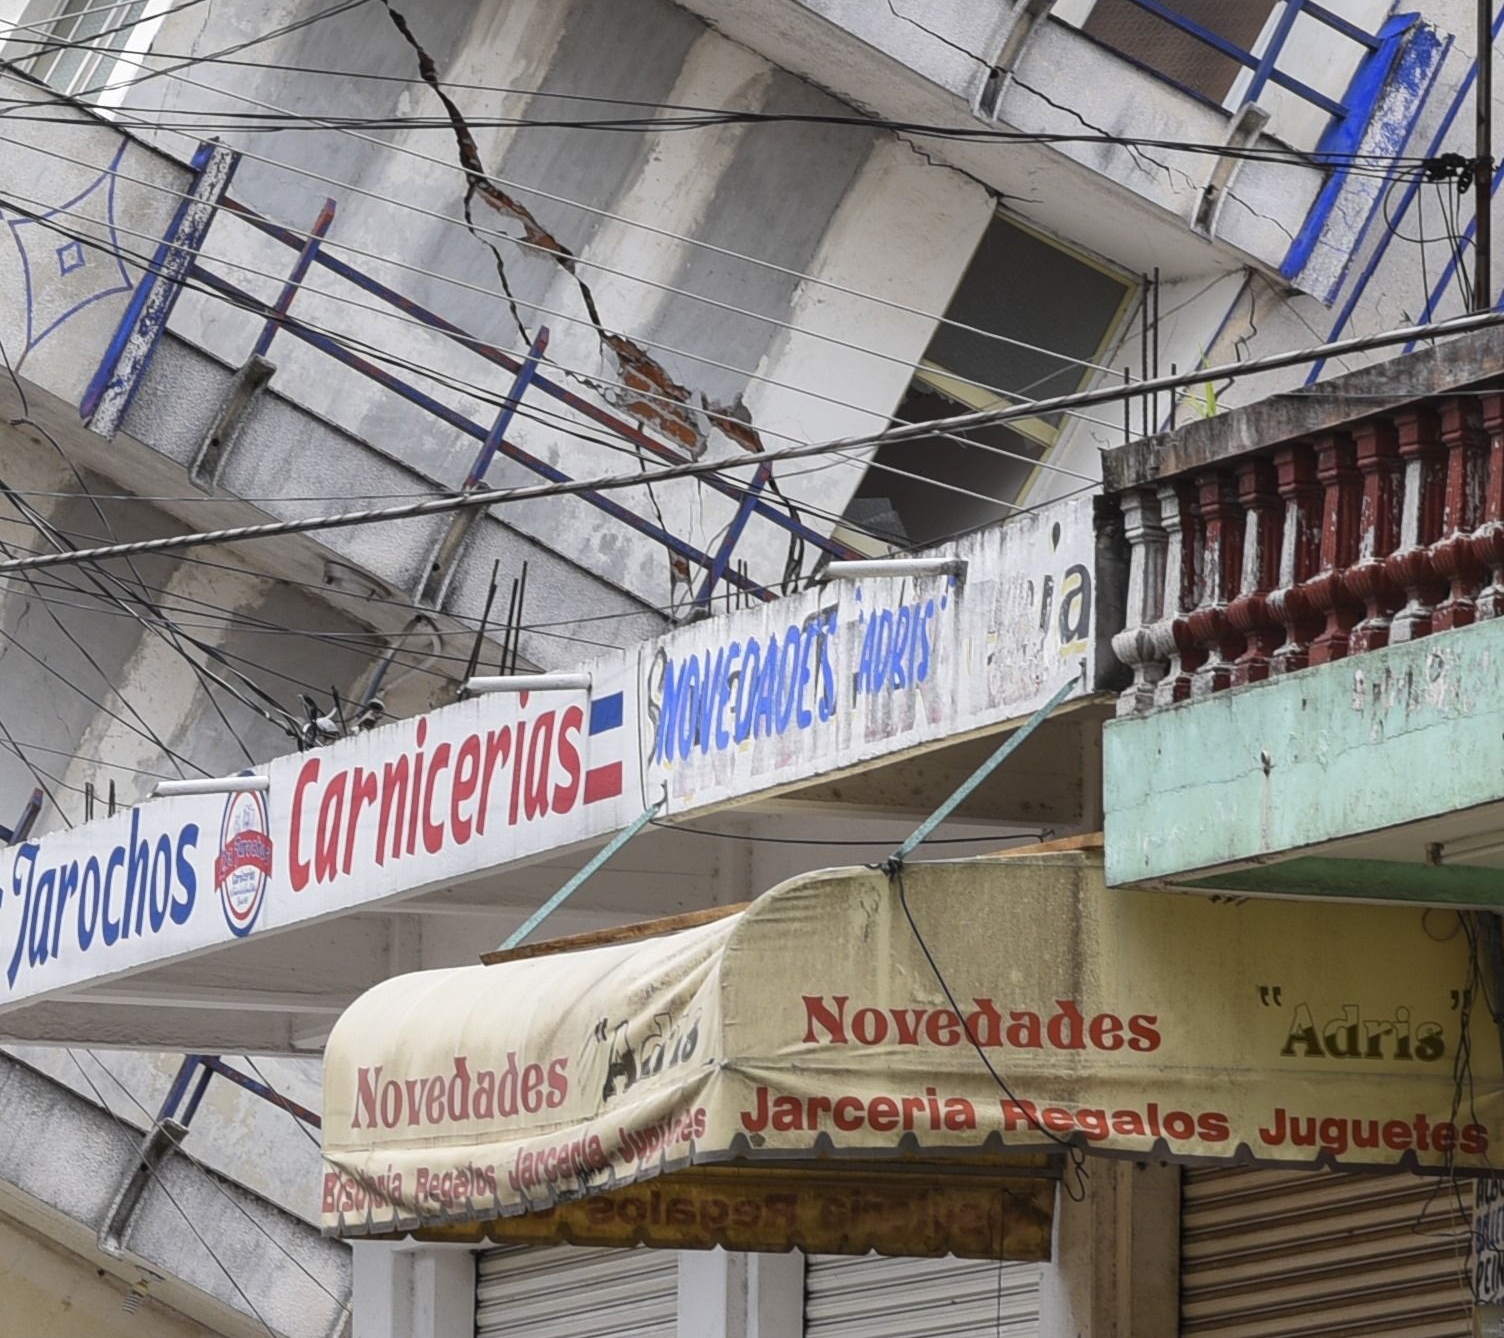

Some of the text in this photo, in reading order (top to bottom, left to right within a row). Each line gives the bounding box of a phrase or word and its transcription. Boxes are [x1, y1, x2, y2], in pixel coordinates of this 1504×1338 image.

[656, 611, 838, 767] NOVEDADES
[6, 807, 200, 991] Jarochos
[802, 995, 1162, 1053] Novedades
[351, 1051, 569, 1129] Novedades
[741, 1085, 976, 1133] Jarceria
[1000, 1098, 1230, 1142] Regalos
[1258, 1107, 1489, 1155] Juguetes
[415, 1161, 498, 1210] Regalos
